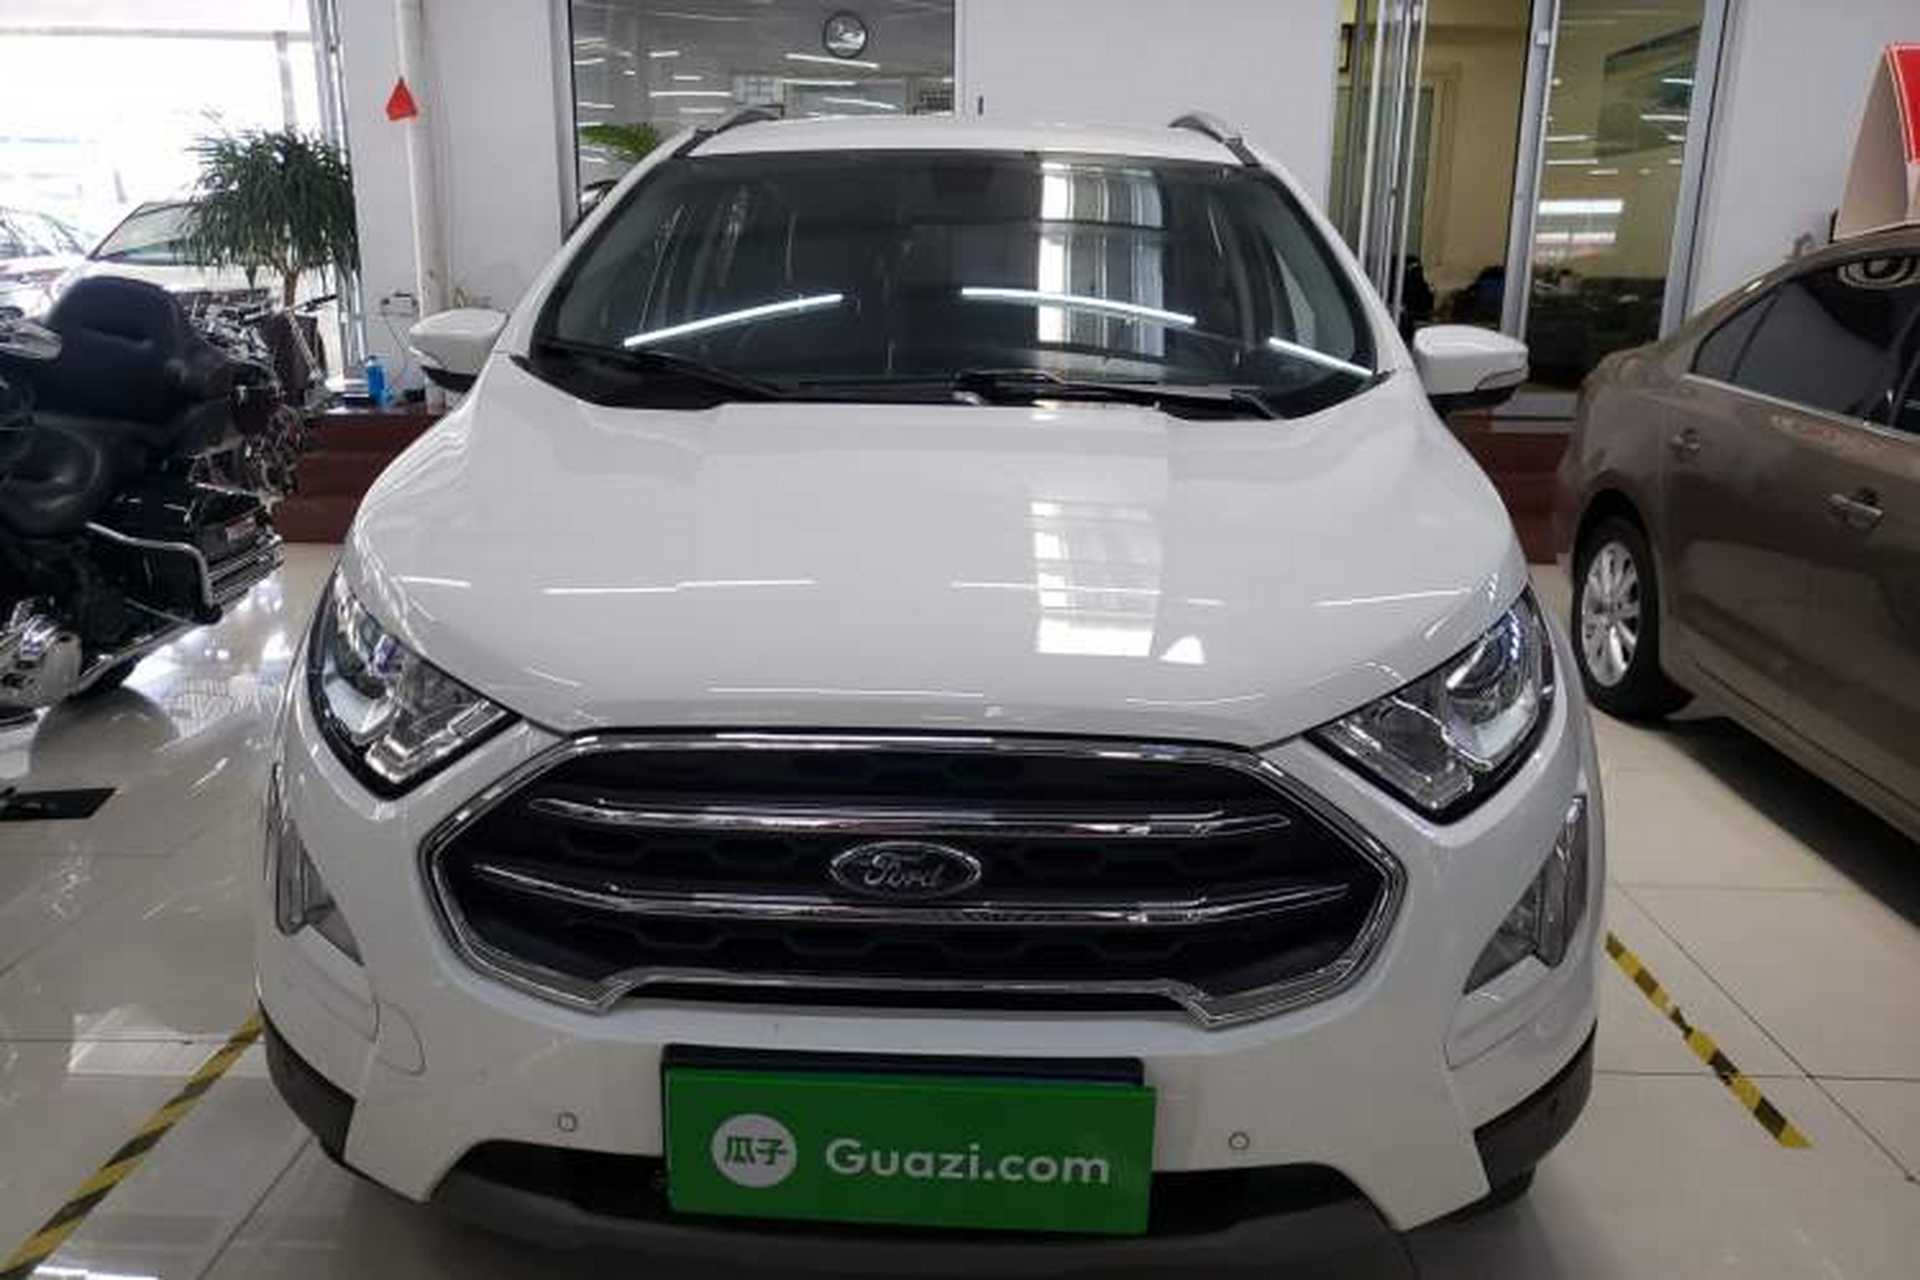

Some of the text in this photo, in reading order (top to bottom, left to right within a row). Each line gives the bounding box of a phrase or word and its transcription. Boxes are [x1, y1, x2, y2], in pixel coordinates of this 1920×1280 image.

[862, 851, 946, 888] Ford
[722, 1135, 789, 1167] 瓜子
[824, 1137, 1111, 1185] Guazi.com
